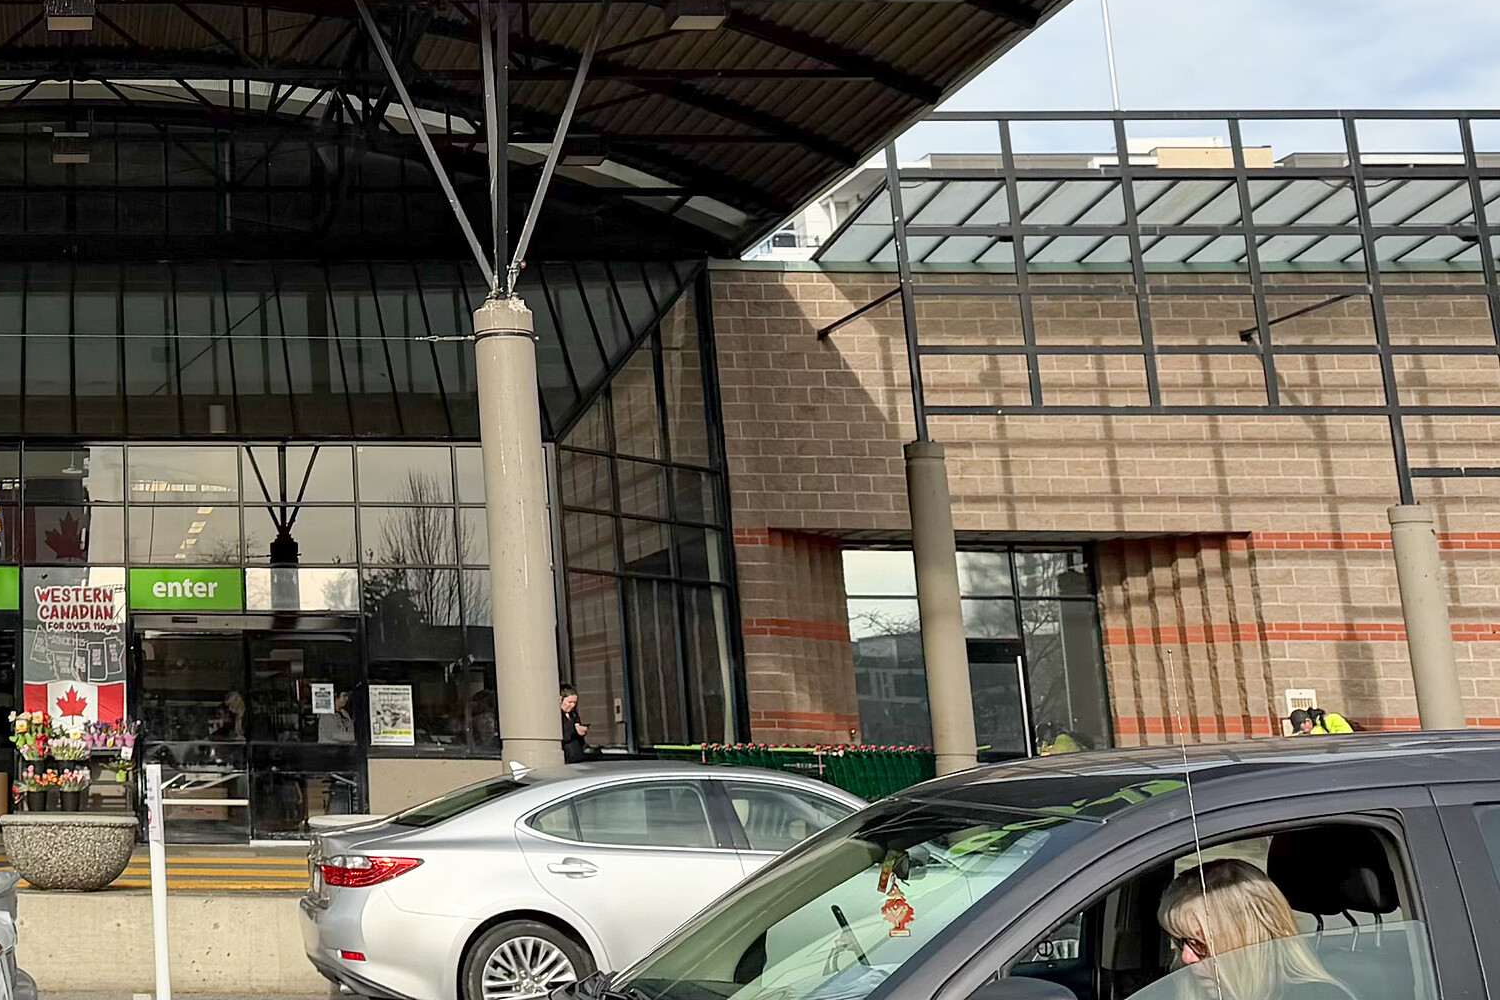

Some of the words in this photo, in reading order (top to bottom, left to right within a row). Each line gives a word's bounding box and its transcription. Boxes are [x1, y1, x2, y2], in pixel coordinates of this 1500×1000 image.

[35, 586, 114, 603] WESTERN
[152, 577, 218, 599] enter
[39, 604, 114, 620] CANADIAN
[48, 622, 64, 630] FOR
[66, 622, 90, 631] OVER
